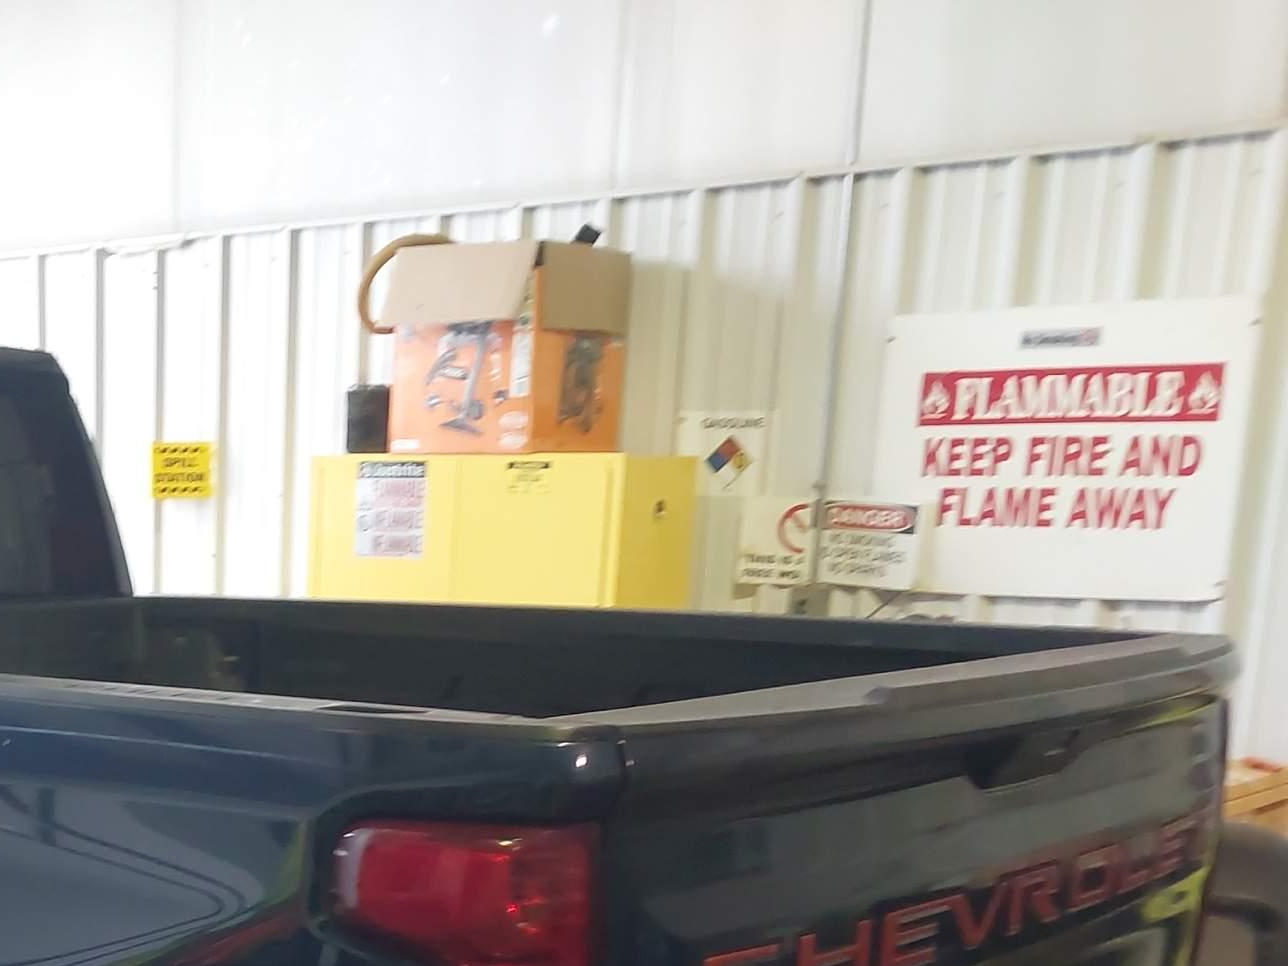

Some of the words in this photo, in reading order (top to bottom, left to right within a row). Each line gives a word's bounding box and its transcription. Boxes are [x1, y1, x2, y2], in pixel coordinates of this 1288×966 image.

[951, 372, 1186, 420] FLAMMABLE
[921, 435, 1013, 478] KEEP
[1024, 434, 1112, 477] FIRE
[1119, 434, 1204, 477] AND
[936, 486, 1059, 528] FLAME
[1065, 486, 1177, 529] AWAY
